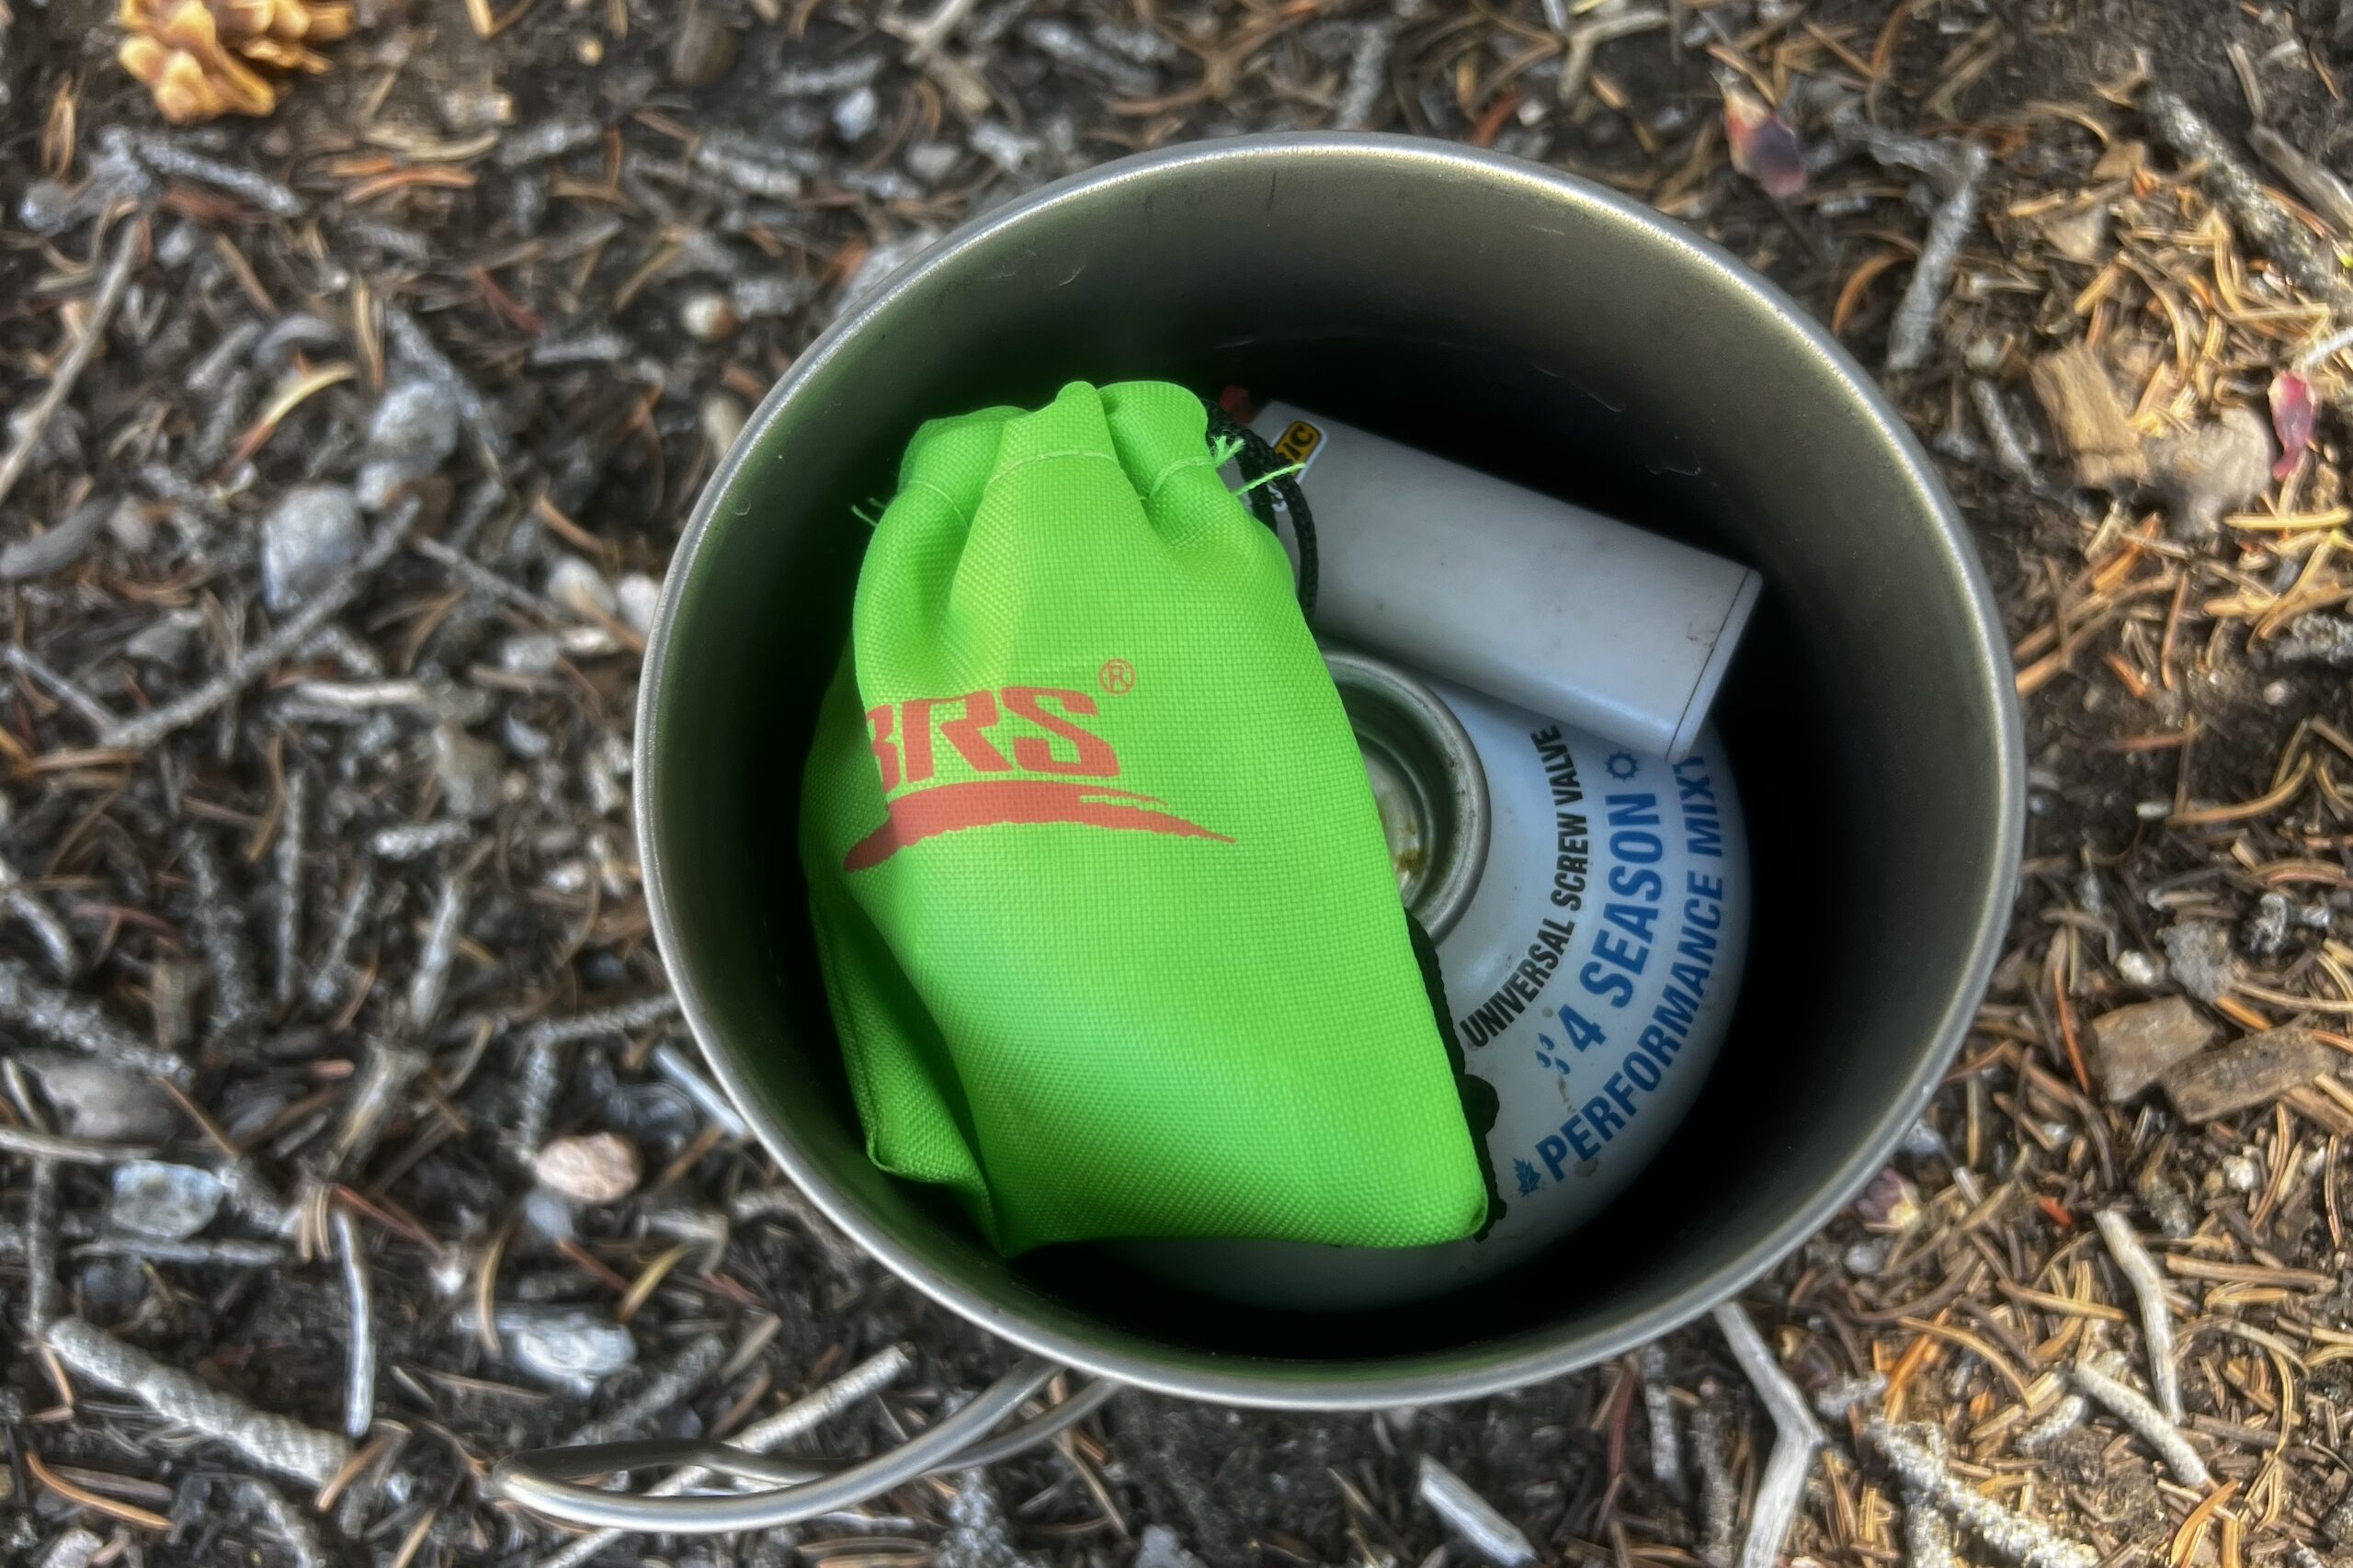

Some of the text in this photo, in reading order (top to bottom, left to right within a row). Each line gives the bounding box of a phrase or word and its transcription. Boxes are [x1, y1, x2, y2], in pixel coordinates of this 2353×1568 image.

[1277, 423, 1314, 461] IC
[1460, 724, 1588, 1049] UNIVERSAL SCREW VALVE
[1535, 873, 1724, 1182] PERFORMANCE
[1558, 792, 1663, 1052] 4 SEASON
